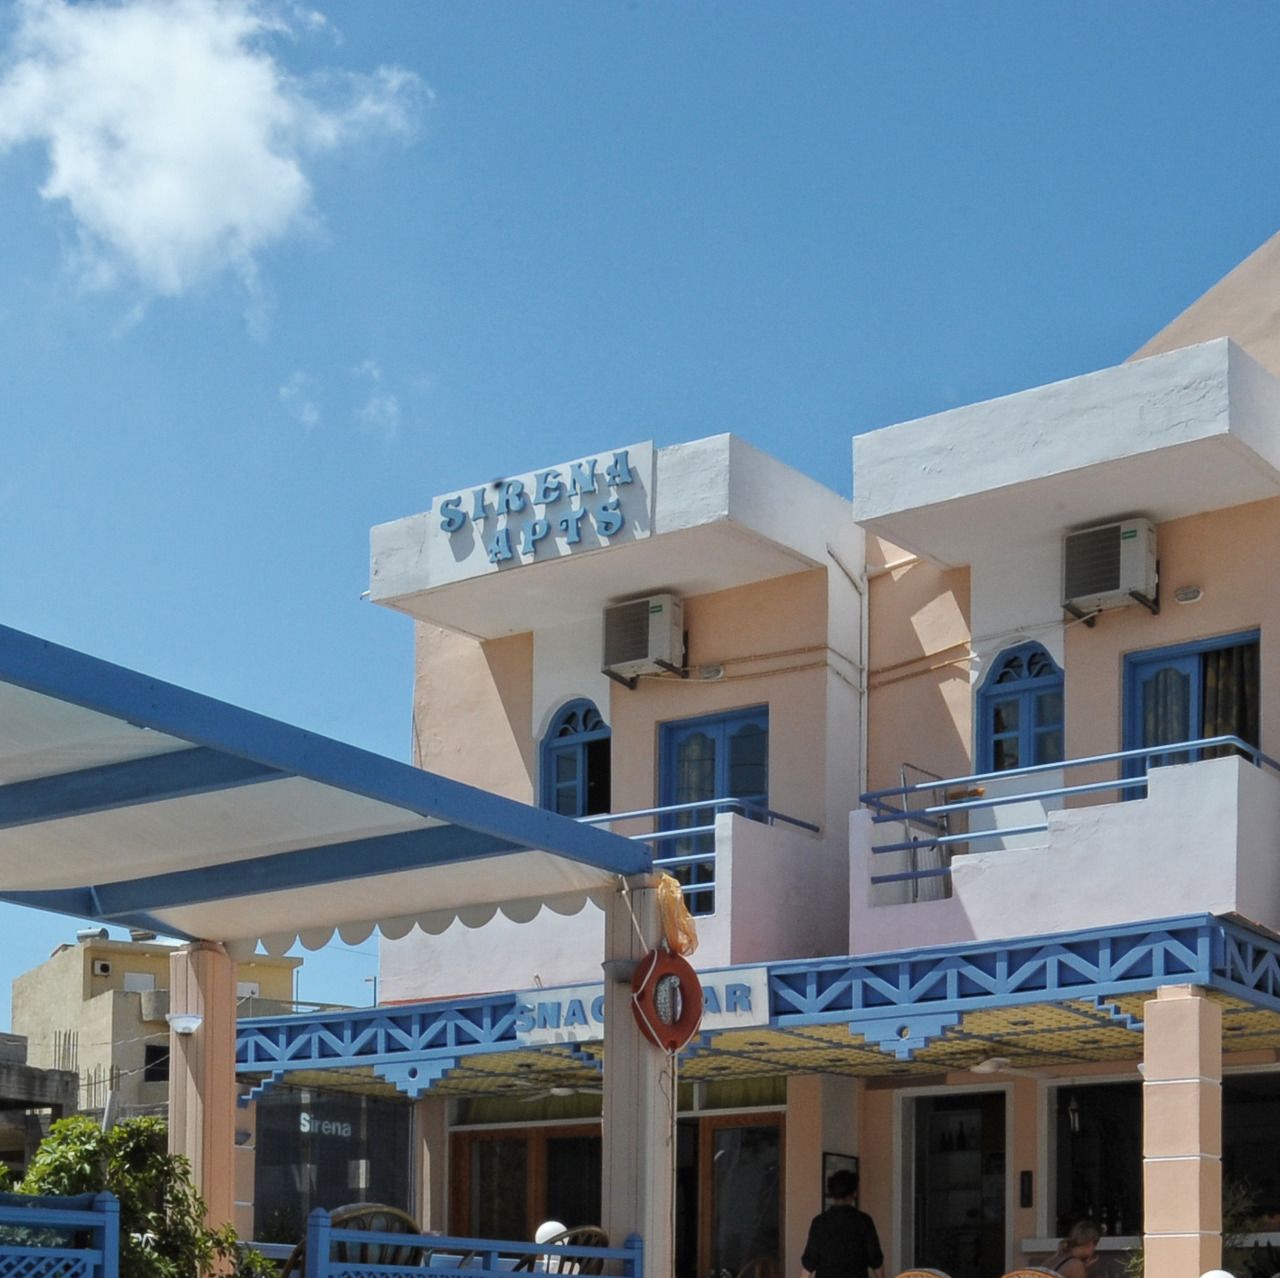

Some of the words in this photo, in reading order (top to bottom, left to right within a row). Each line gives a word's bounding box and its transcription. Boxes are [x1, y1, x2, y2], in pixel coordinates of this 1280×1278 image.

[440, 450, 634, 533] SIRENA
[489, 498, 624, 564] APTS
[515, 995, 604, 1033] SNAC
[703, 982, 752, 1014] AR
[300, 1112, 351, 1136] Sirena
